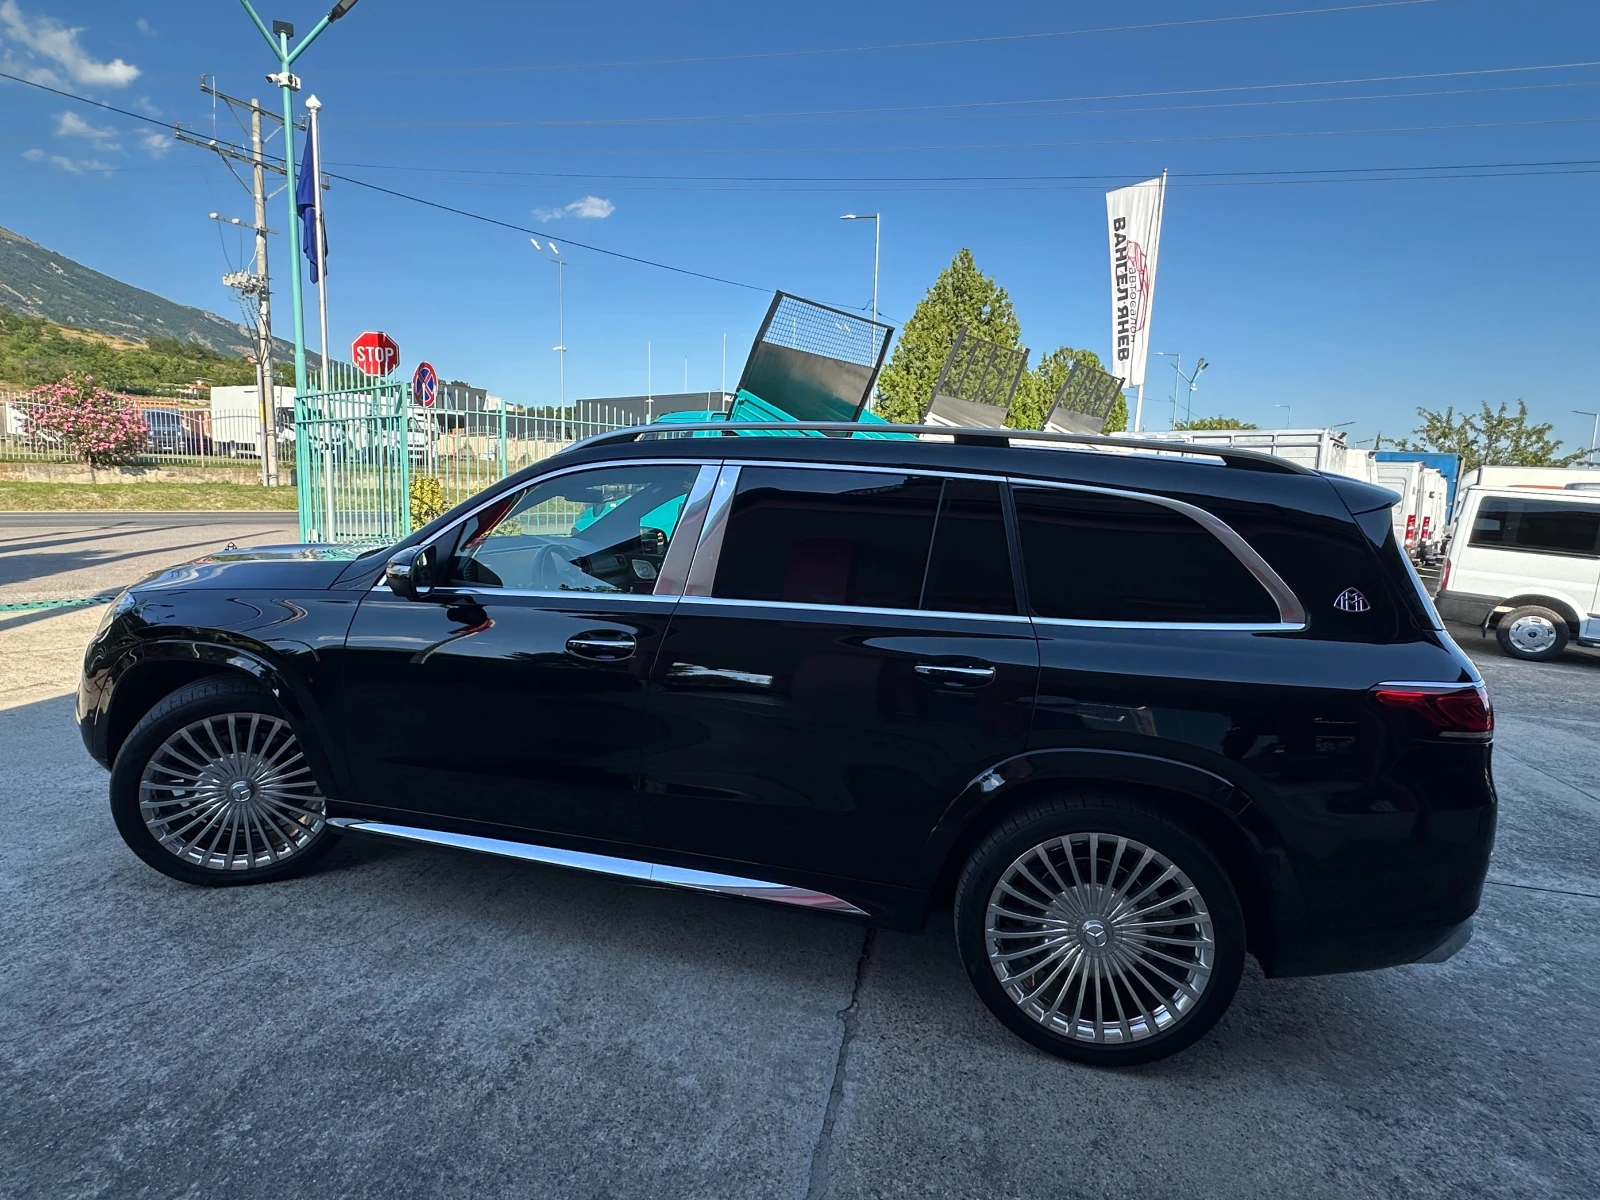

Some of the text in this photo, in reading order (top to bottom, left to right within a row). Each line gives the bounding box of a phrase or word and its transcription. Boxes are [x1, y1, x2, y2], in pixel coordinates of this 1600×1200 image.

[1113, 216, 1130, 362] ВАНГЕЛ ЯНЕВ
[356, 345, 394, 363] STOP
